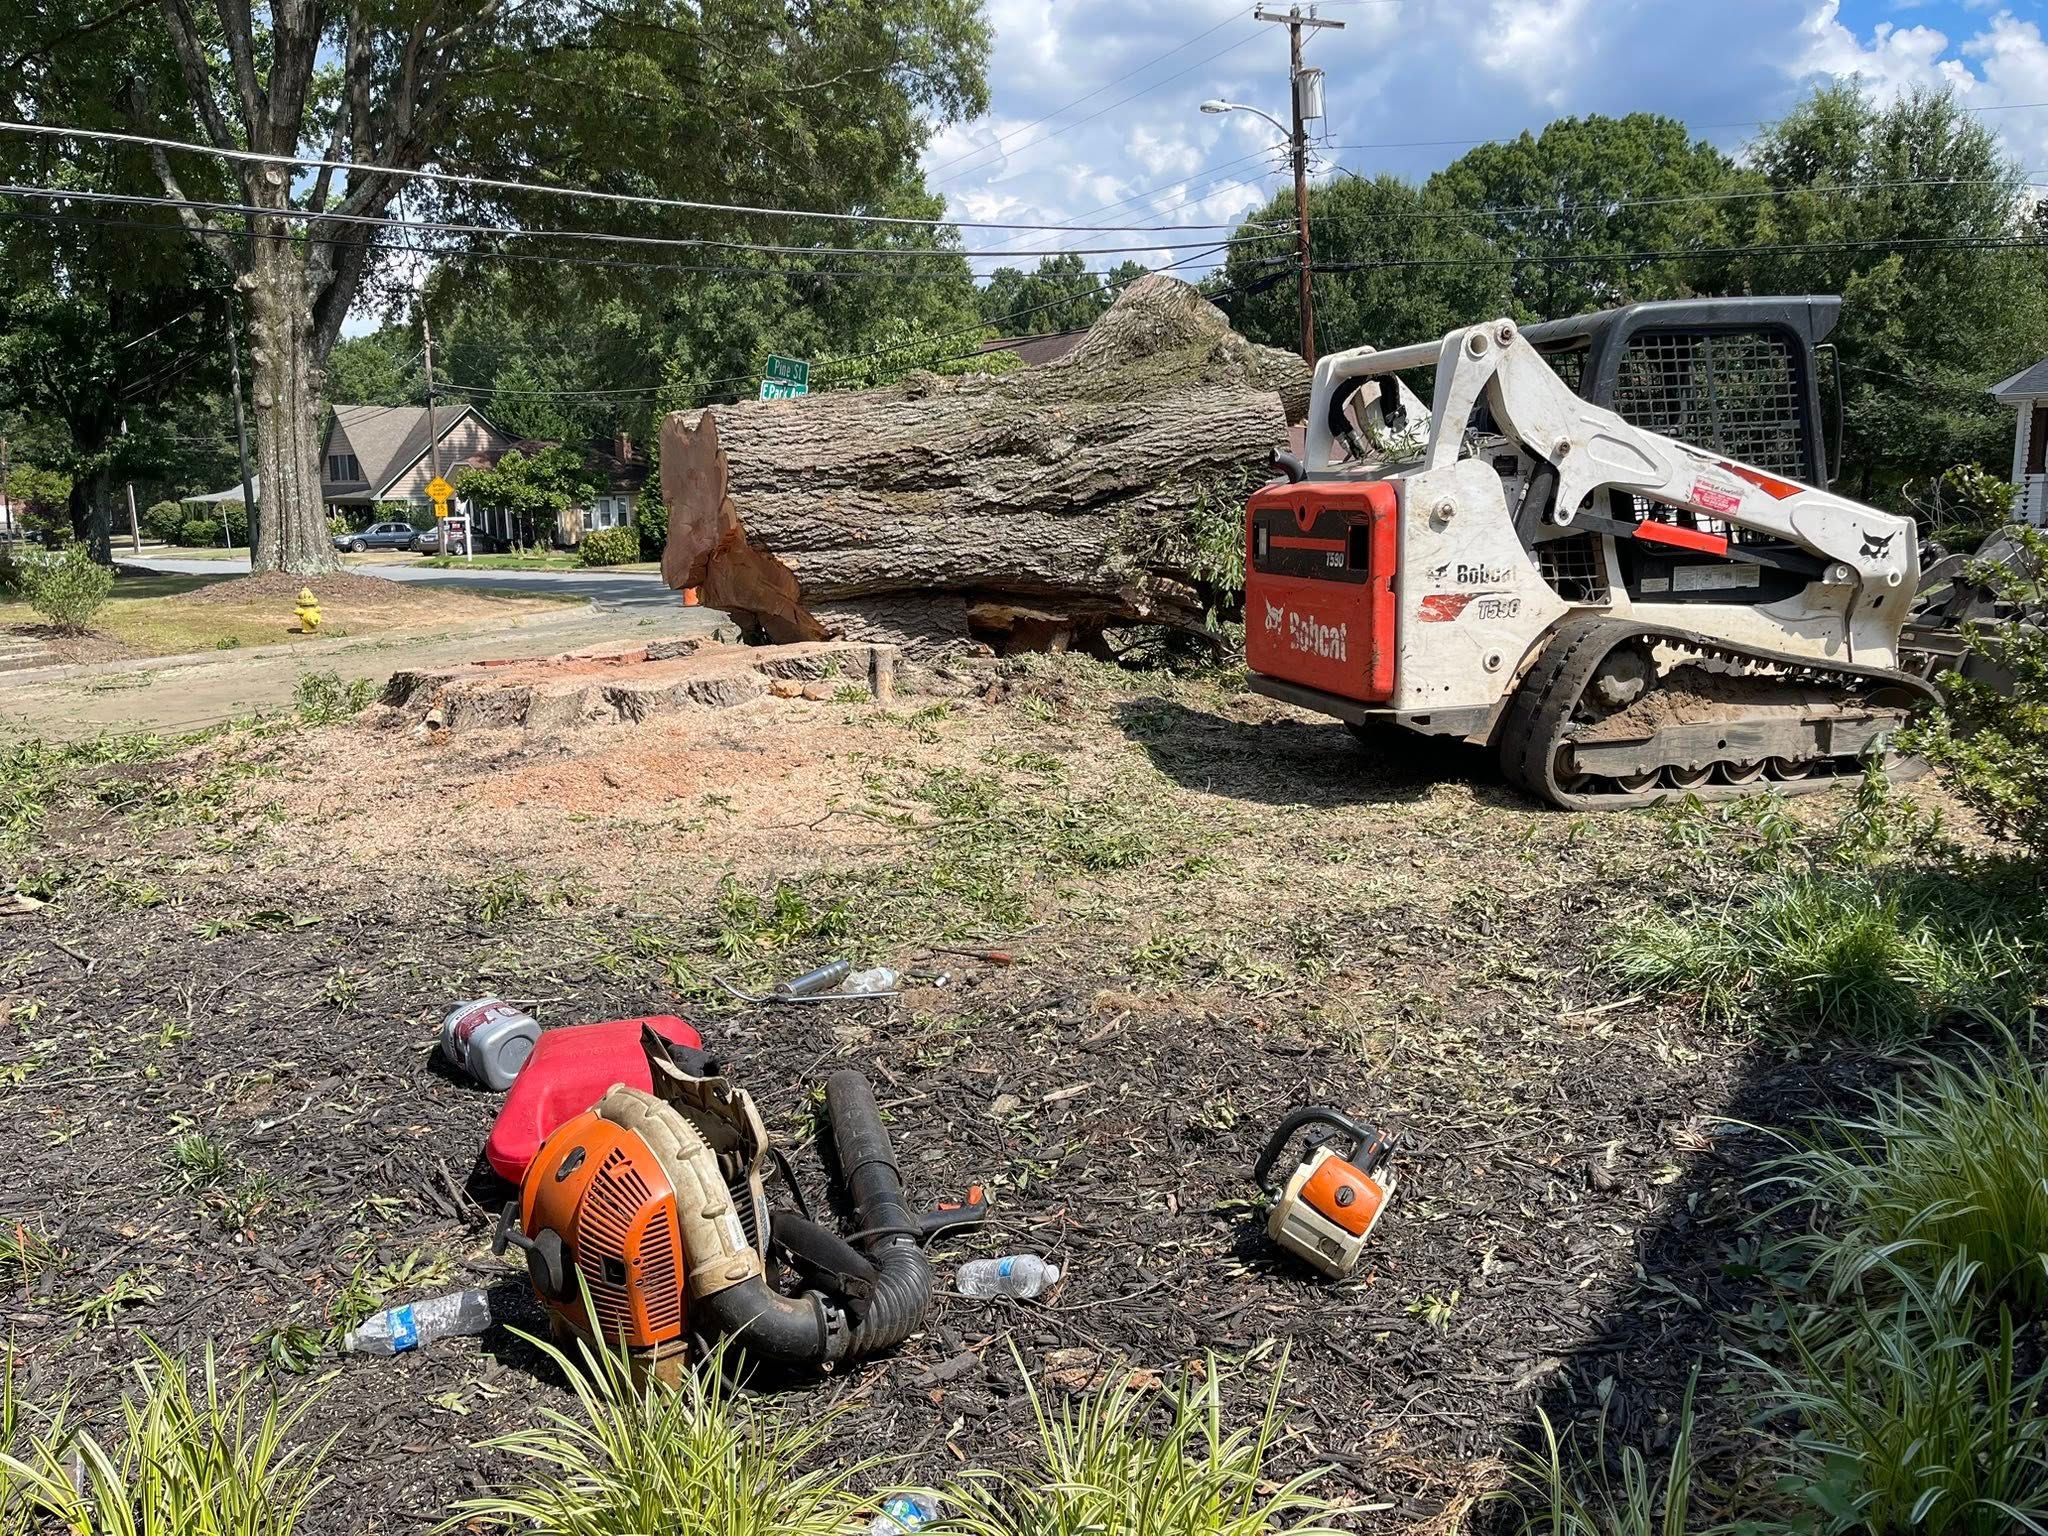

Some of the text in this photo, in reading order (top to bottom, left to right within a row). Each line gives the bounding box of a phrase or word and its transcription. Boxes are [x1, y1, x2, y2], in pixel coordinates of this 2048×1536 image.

[774, 359, 802, 380] Pine St
[763, 384, 769, 399] E
[769, 385, 788, 399] Park
[1326, 552, 1344, 567] T590
[1289, 611, 1347, 662] Bobcat
